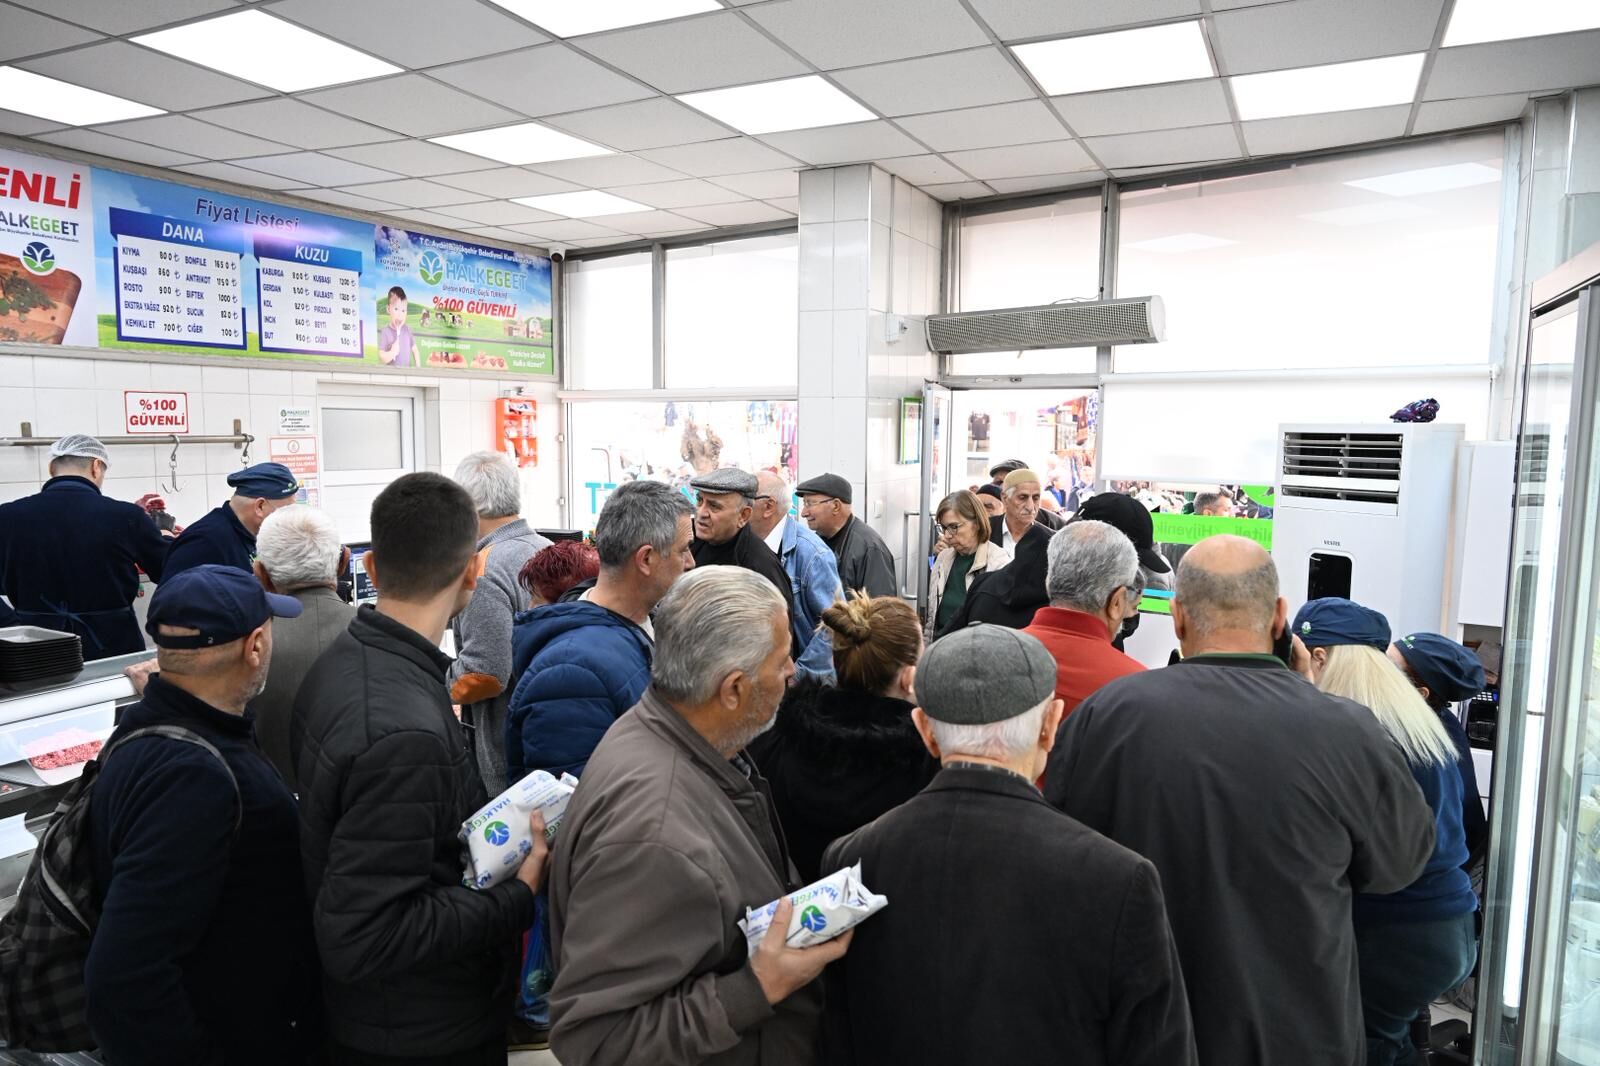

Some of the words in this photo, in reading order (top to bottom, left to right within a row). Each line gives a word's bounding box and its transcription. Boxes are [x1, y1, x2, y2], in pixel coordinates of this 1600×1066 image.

[196, 198, 240, 222] Fiyat
[244, 207, 298, 232] Listesi
[162, 222, 204, 242] DANA
[122, 247, 140, 256] KIYMA
[295, 245, 329, 262] KUZU
[446, 262, 527, 290] HALKEGEET
[124, 283, 143, 292] ROSTO
[124, 301, 142, 310] EKSTRA
[432, 296, 464, 312] %100
[466, 299, 517, 318] GÜVENLİ
[140, 399, 177, 410] %100
[130, 412, 185, 425] GÜVENLİ
